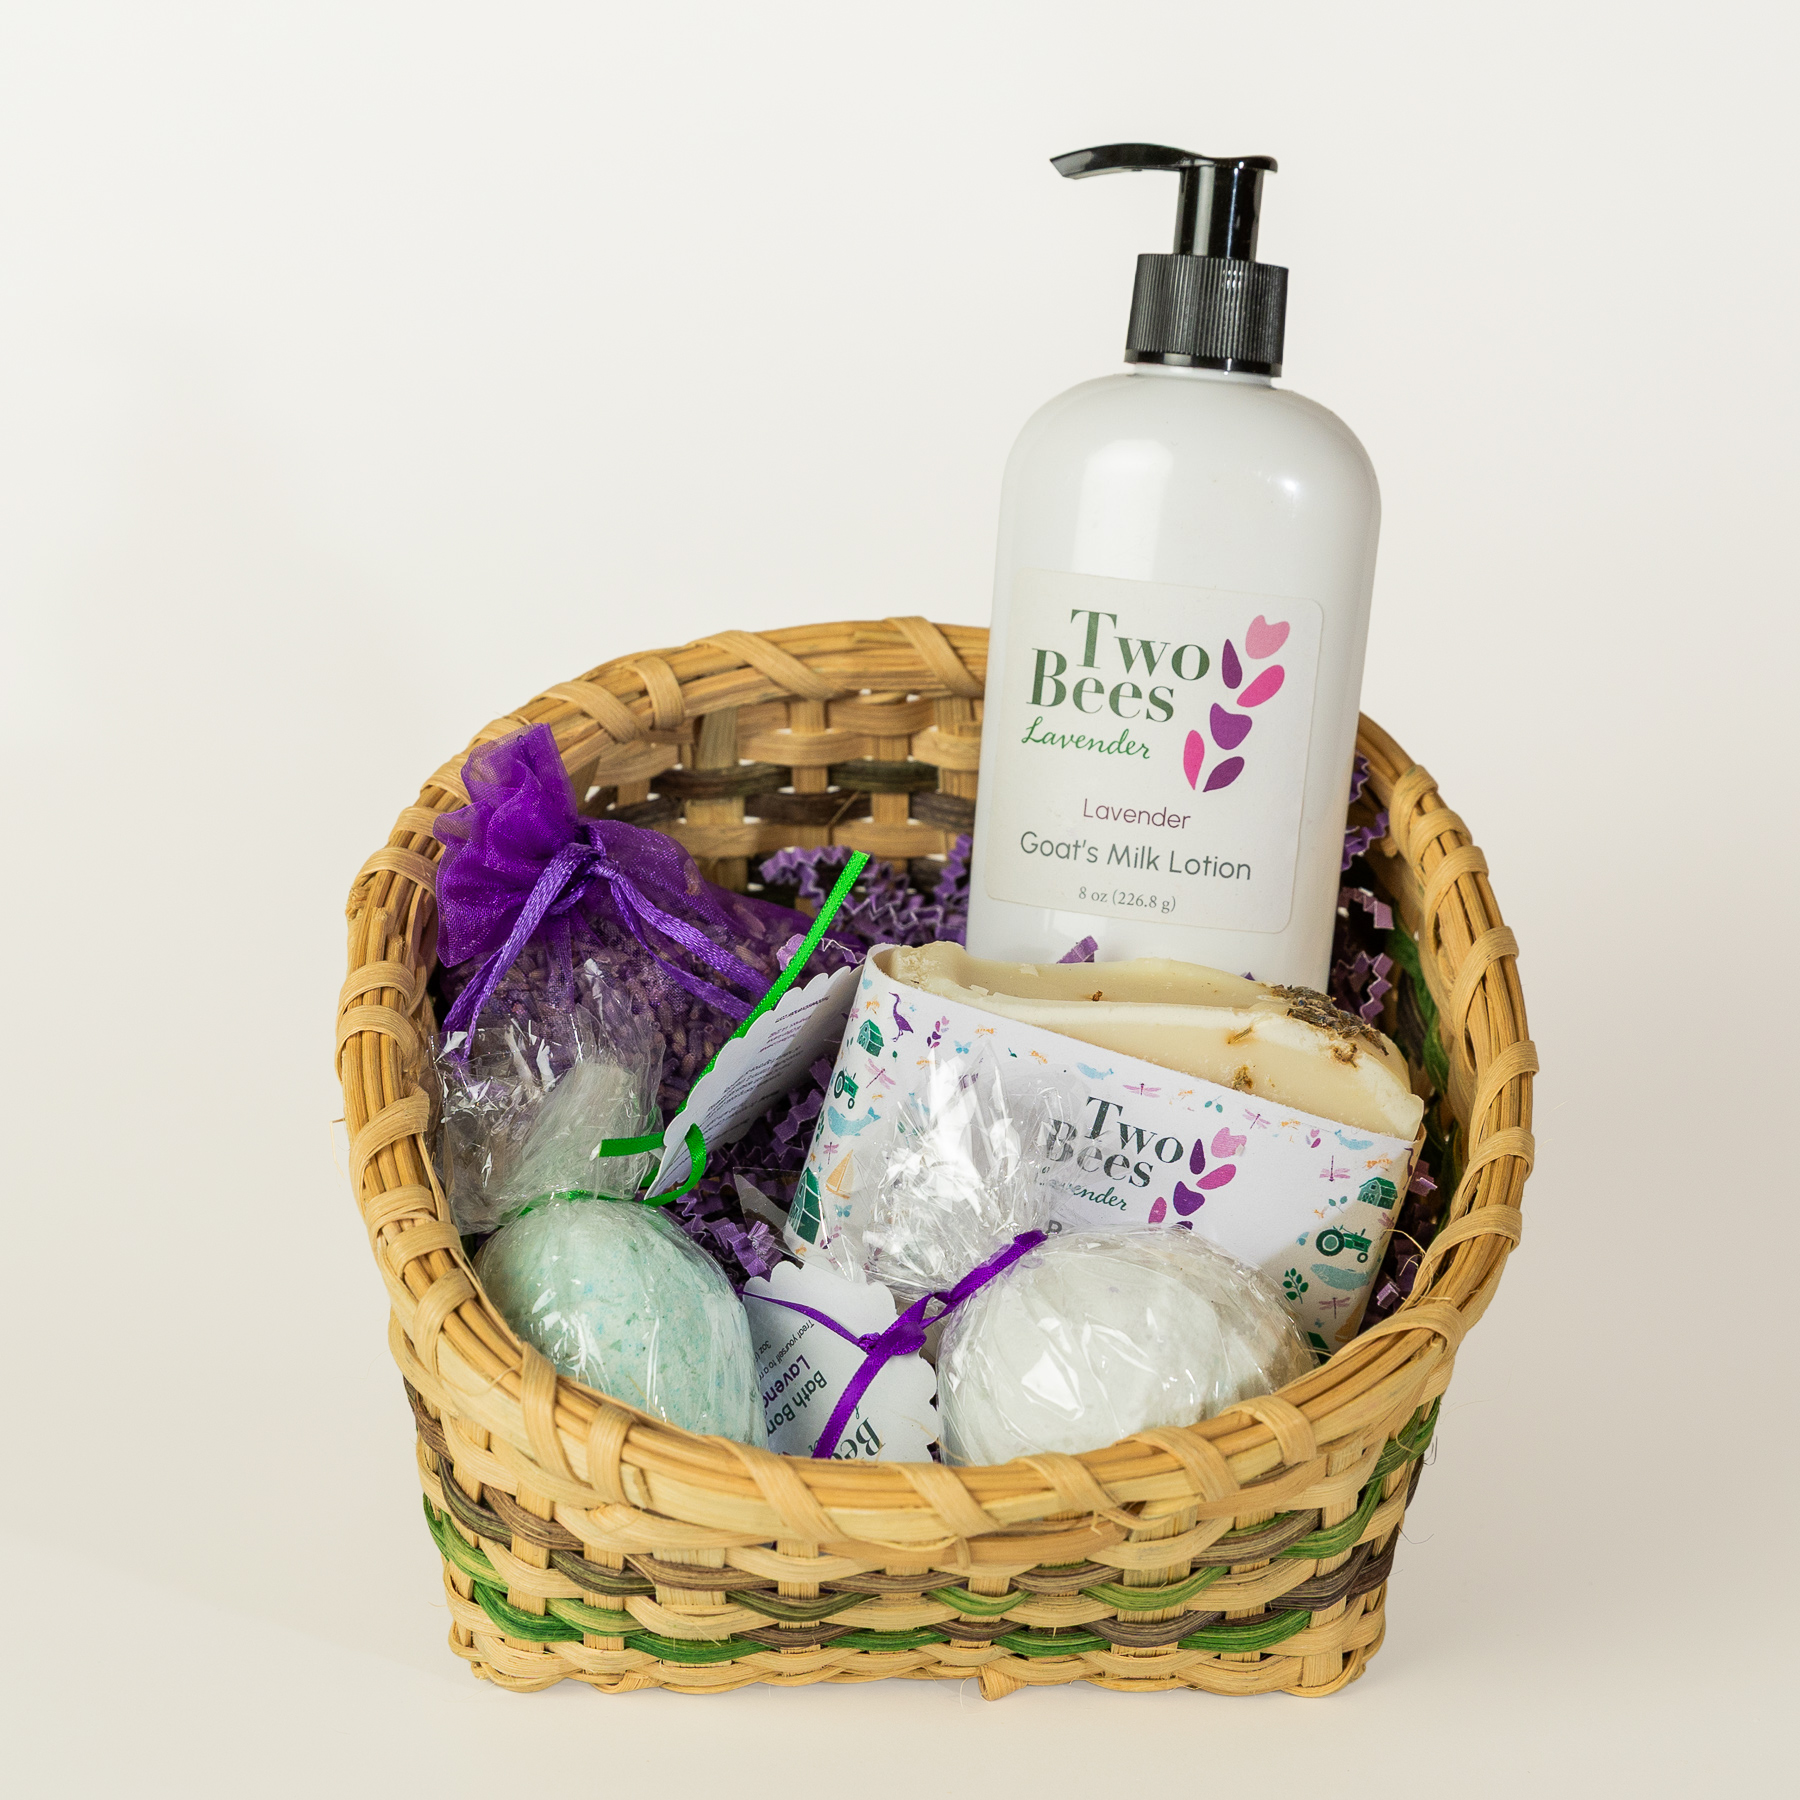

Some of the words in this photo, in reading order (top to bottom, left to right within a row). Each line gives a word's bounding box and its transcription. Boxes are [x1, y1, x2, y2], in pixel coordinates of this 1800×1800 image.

[1070, 608, 1210, 681] Two
[1026, 647, 1175, 723] Bees
[1020, 716, 1151, 759] Lavender
[1083, 798, 1191, 829] Lavender
[1020, 831, 1099, 864] Goat's
[1106, 843, 1160, 871] Milk
[1169, 850, 1251, 881] Lotion
[1078, 886, 1088, 900] 8
[1091, 891, 1108, 903] oz
[1112, 889, 1157, 909] (226.8
[1161, 896, 1177, 914] g)
[1046, 1117, 1153, 1188] Bees
[1084, 1096, 1184, 1164] Two
[776, 1334, 798, 1364] yourself
[796, 1319, 815, 1339] Treat
[762, 1354, 811, 1412] Laven
[792, 1370, 827, 1408] Bath
